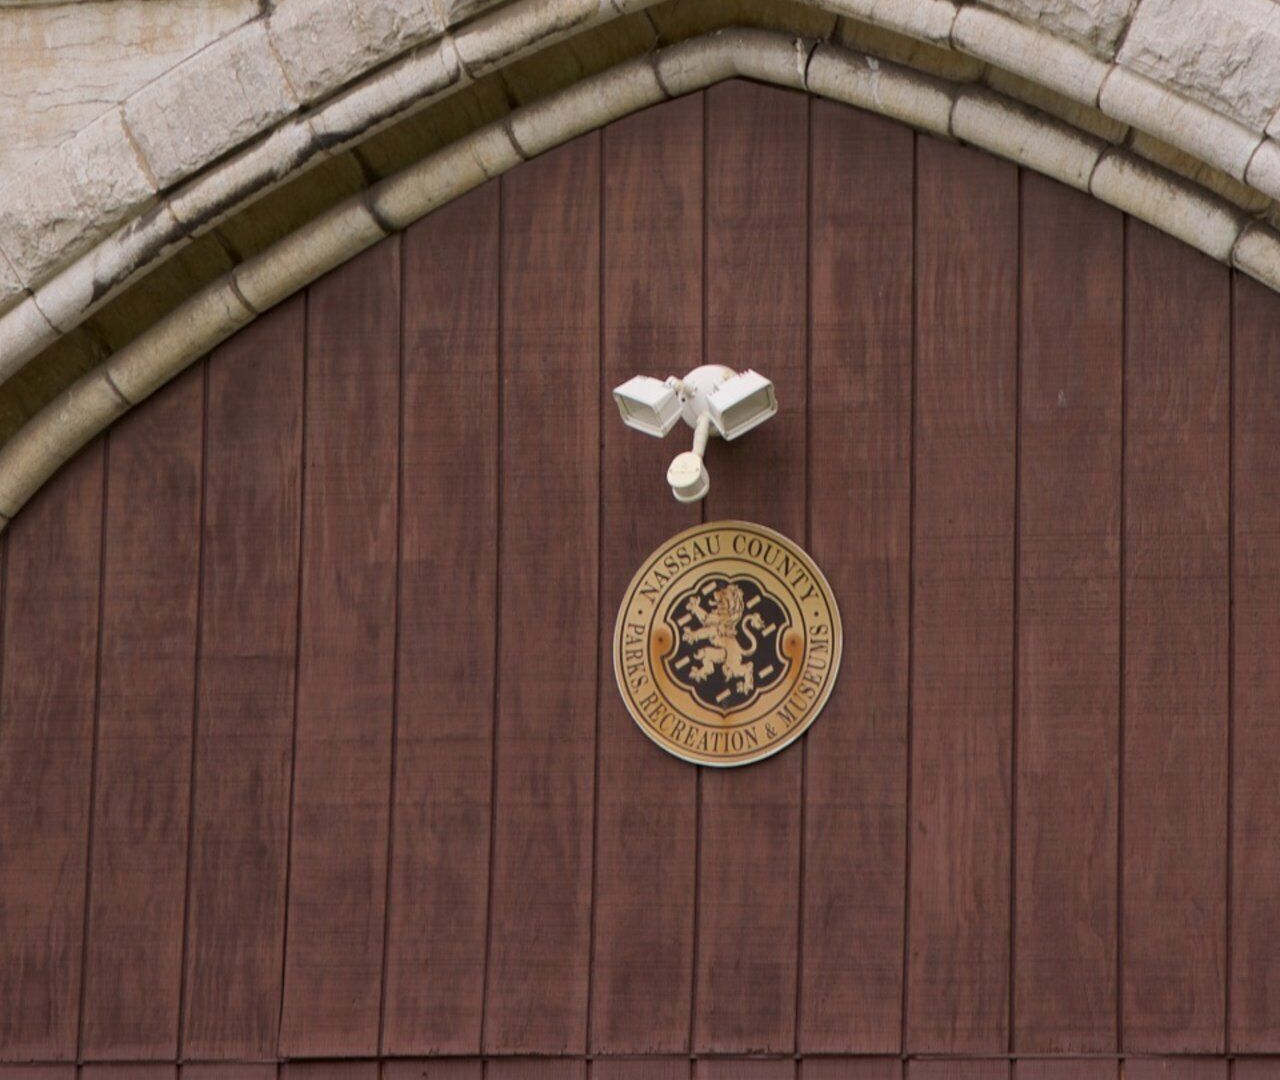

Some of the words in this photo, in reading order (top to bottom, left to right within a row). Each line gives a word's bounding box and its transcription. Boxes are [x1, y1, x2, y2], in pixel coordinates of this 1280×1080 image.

[638, 534, 722, 605] NASSAU
[732, 534, 820, 604] COUNTY
[625, 622, 649, 695] PARKS,
[639, 691, 759, 753] RECREATION
[765, 722, 778, 737] &
[777, 623, 830, 729] MUSEUMS
